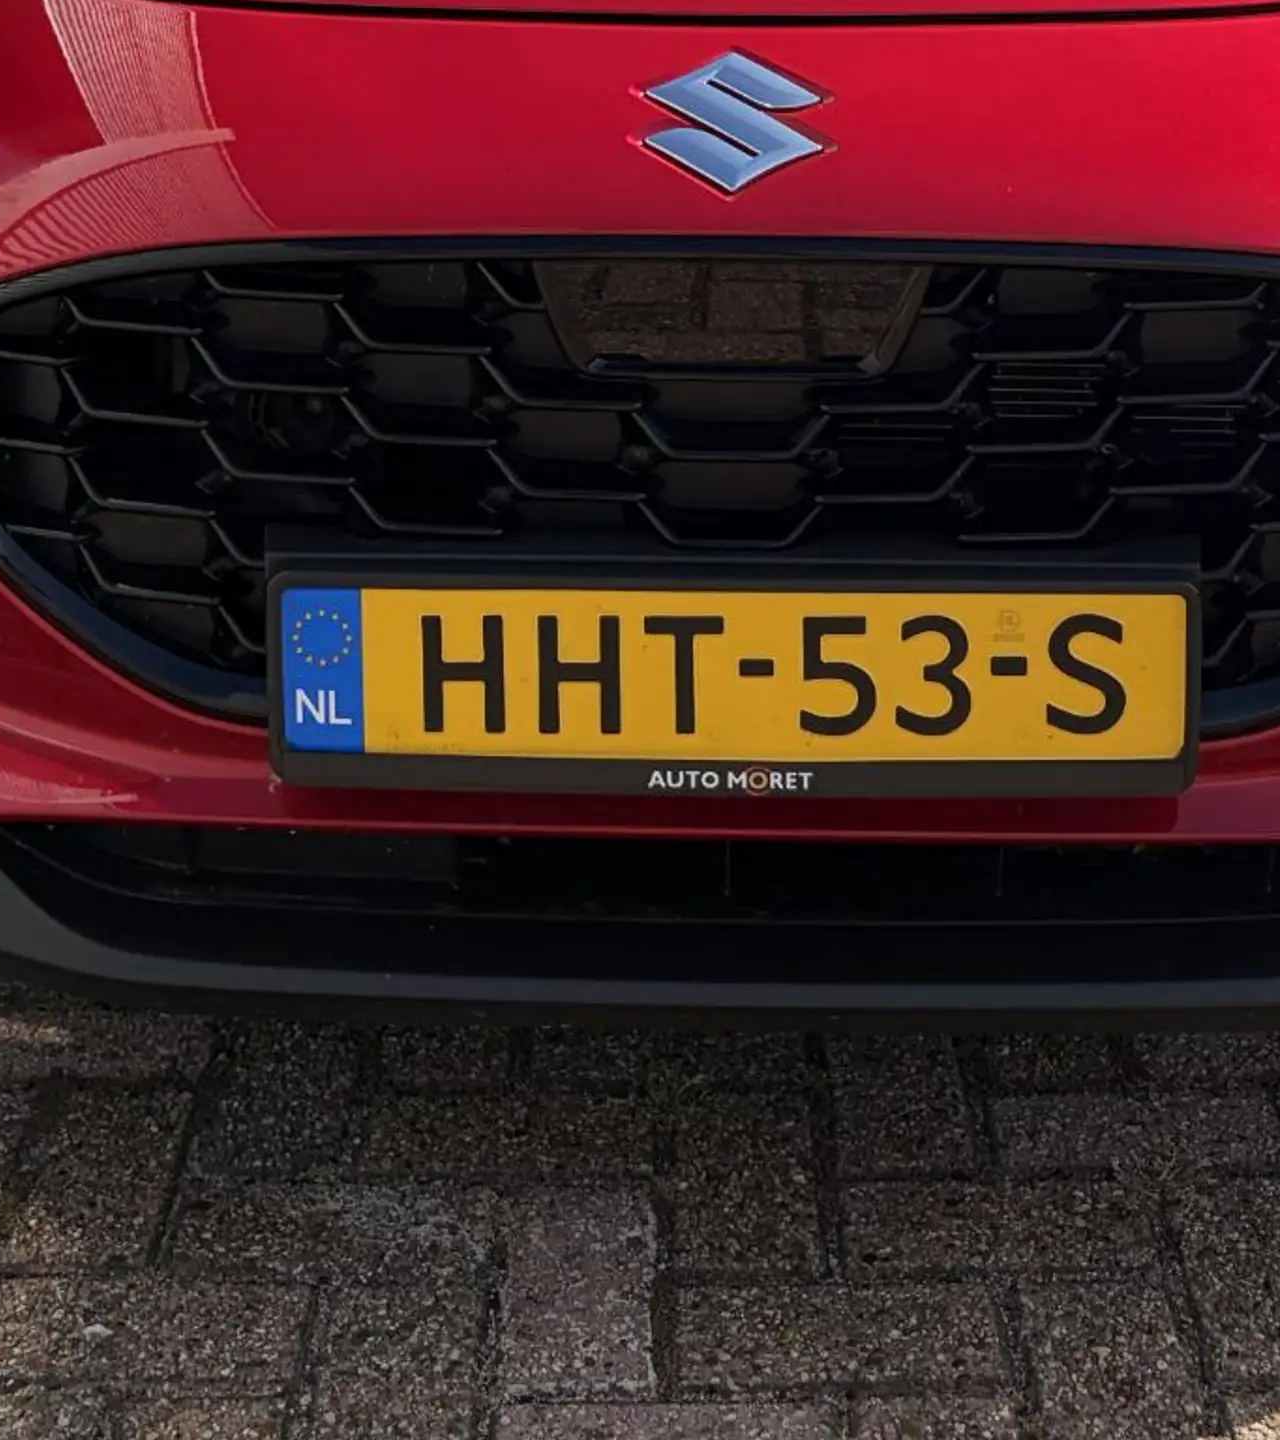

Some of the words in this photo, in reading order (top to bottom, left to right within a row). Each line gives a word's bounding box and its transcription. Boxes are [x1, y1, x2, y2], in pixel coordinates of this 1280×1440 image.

[419, 614, 1127, 738] HHT-53-S
[294, 688, 352, 728] NL
[647, 770, 720, 789] AUTO
[727, 770, 813, 791] MORET
